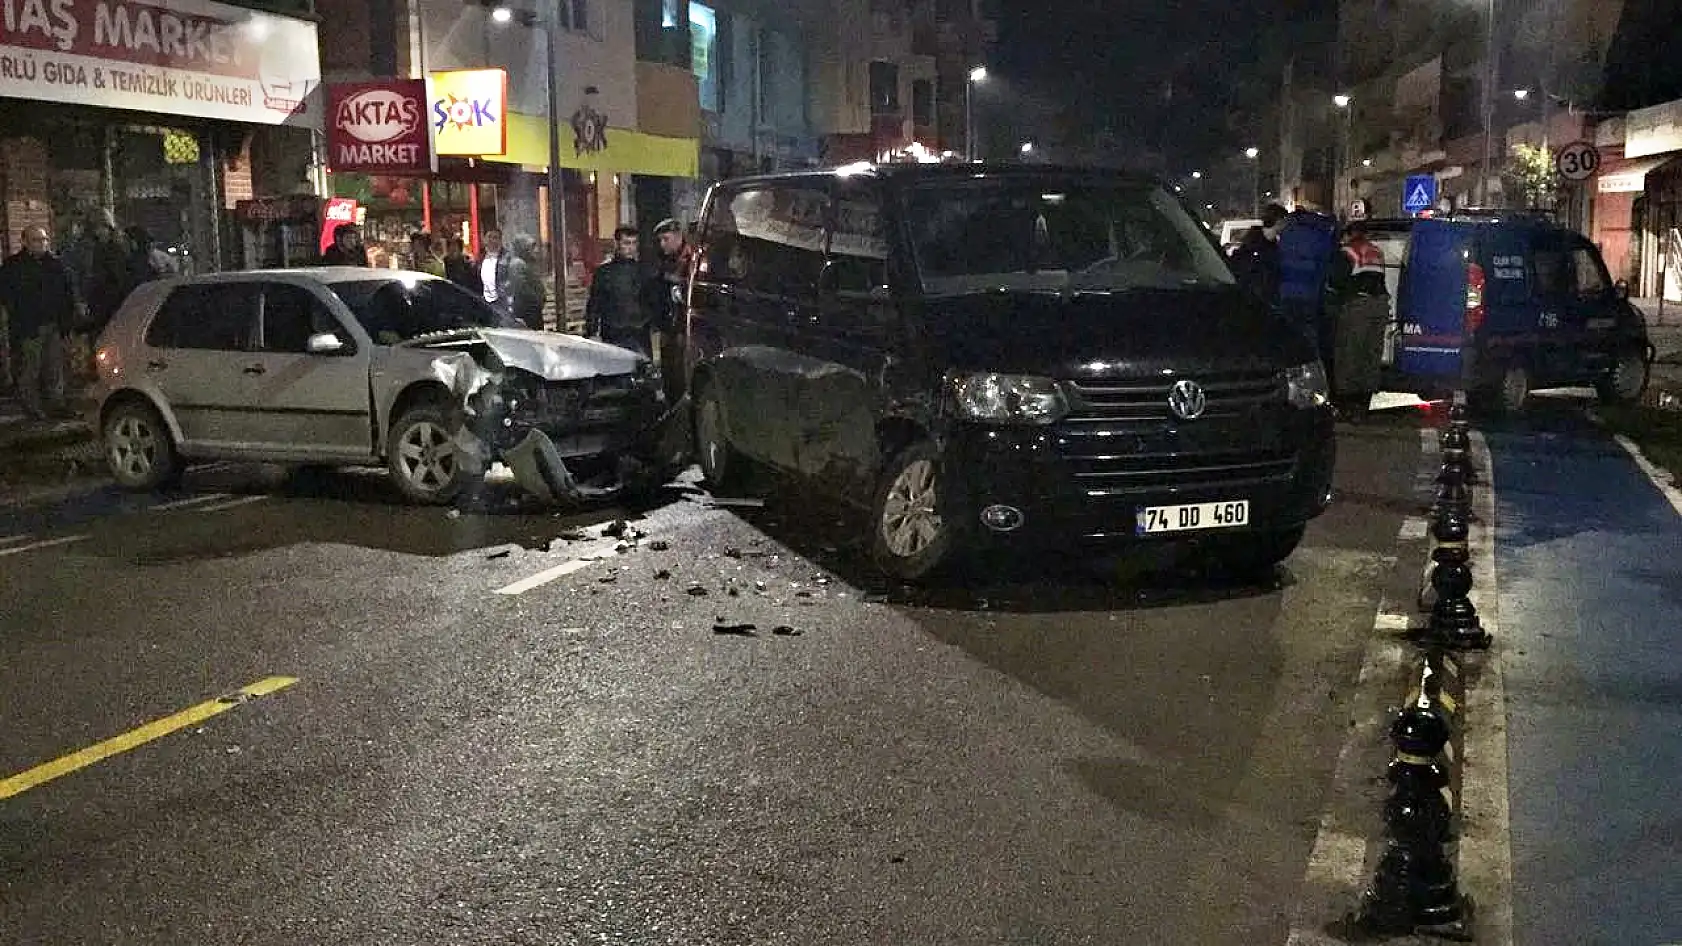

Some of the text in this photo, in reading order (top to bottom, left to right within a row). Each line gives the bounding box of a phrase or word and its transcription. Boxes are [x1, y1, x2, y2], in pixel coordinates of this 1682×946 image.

[94, 3, 246, 67] MARKET
[43, 60, 88, 88] GIDA
[94, 67, 106, 90] &
[110, 68, 178, 97] TEMİZLİK
[184, 76, 252, 106] ÜRÜNLERİ
[337, 98, 419, 129] AKTAŞ
[434, 93, 497, 134] ŞOK
[338, 144, 420, 164] MARKET
[1564, 150, 1594, 174] 30
[1147, 509, 1168, 530] 74
[1179, 506, 1200, 528] DD
[1213, 502, 1244, 524] 460
